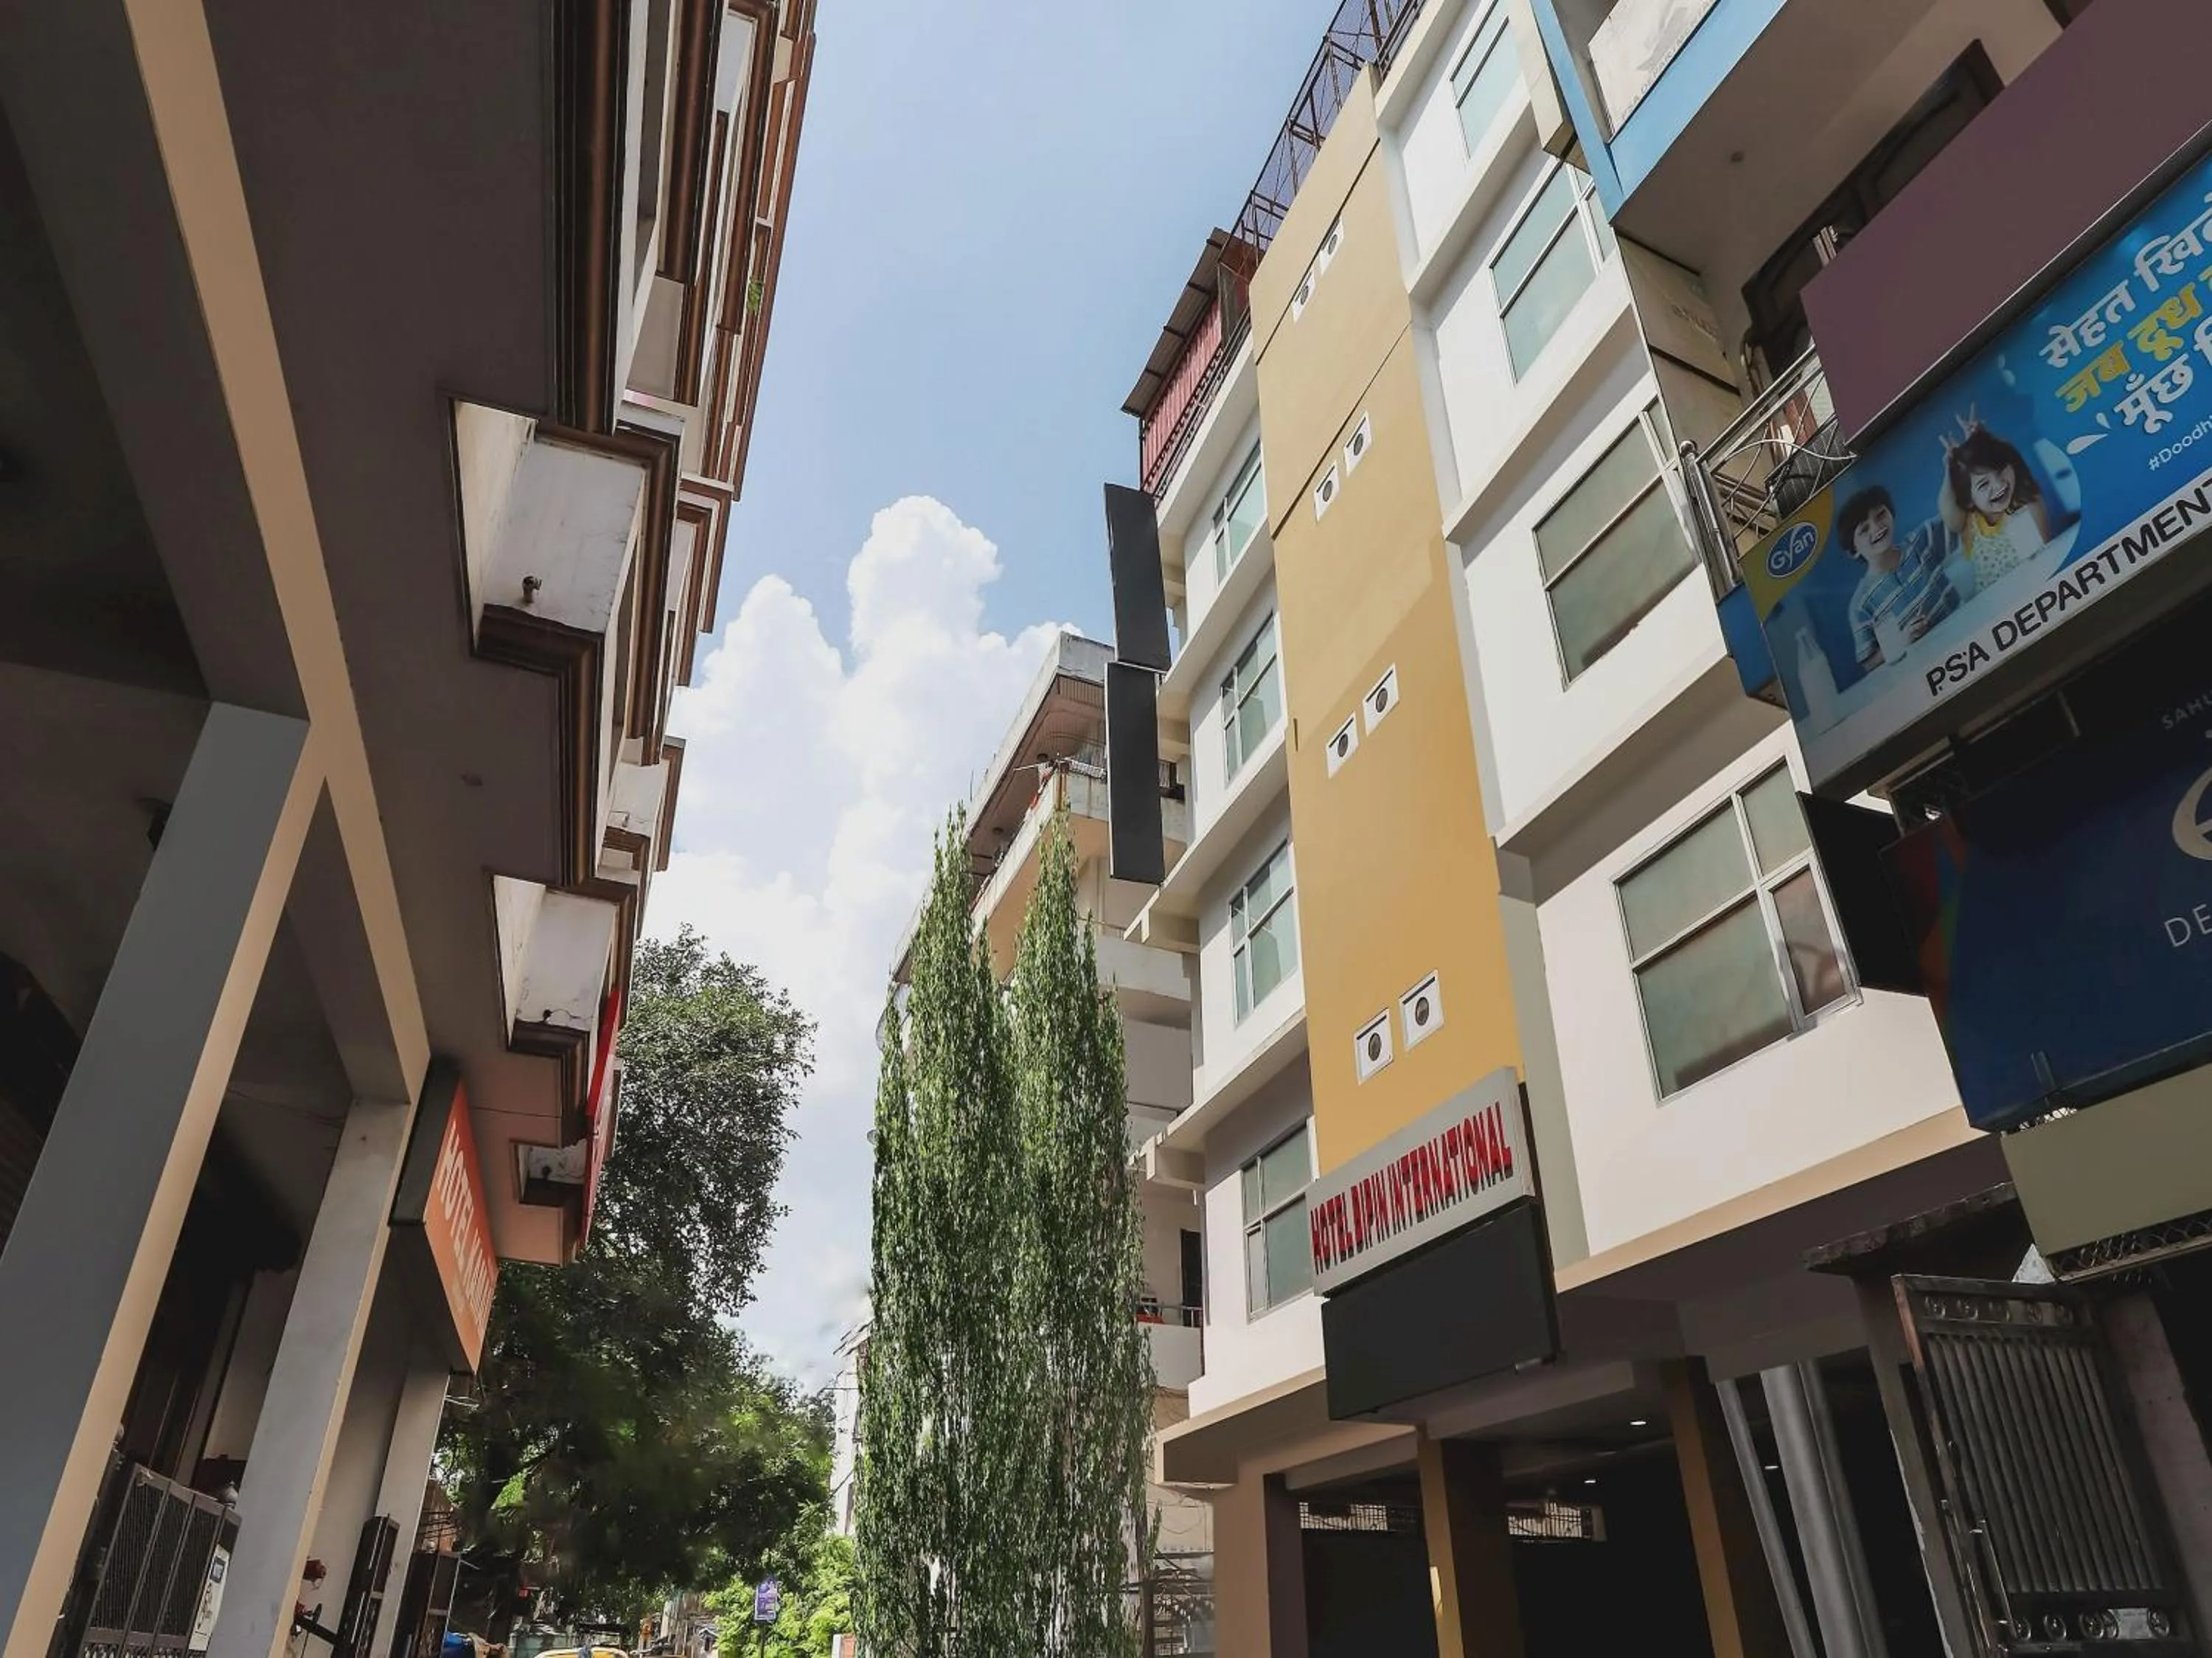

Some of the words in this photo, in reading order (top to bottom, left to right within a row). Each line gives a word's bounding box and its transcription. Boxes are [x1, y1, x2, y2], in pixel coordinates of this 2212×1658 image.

[2039, 279, 2137, 369] सेहत
[2055, 340, 2131, 413] जब
[2126, 282, 2203, 361] दूध
[2148, 414, 2212, 471] #Doodh
[1770, 524, 1815, 569] Gyan
[437, 1120, 474, 1274] HOTEL
[1310, 1191, 1354, 1274] HOTEL
[1386, 1101, 1514, 1238] INTERNATIONAL
